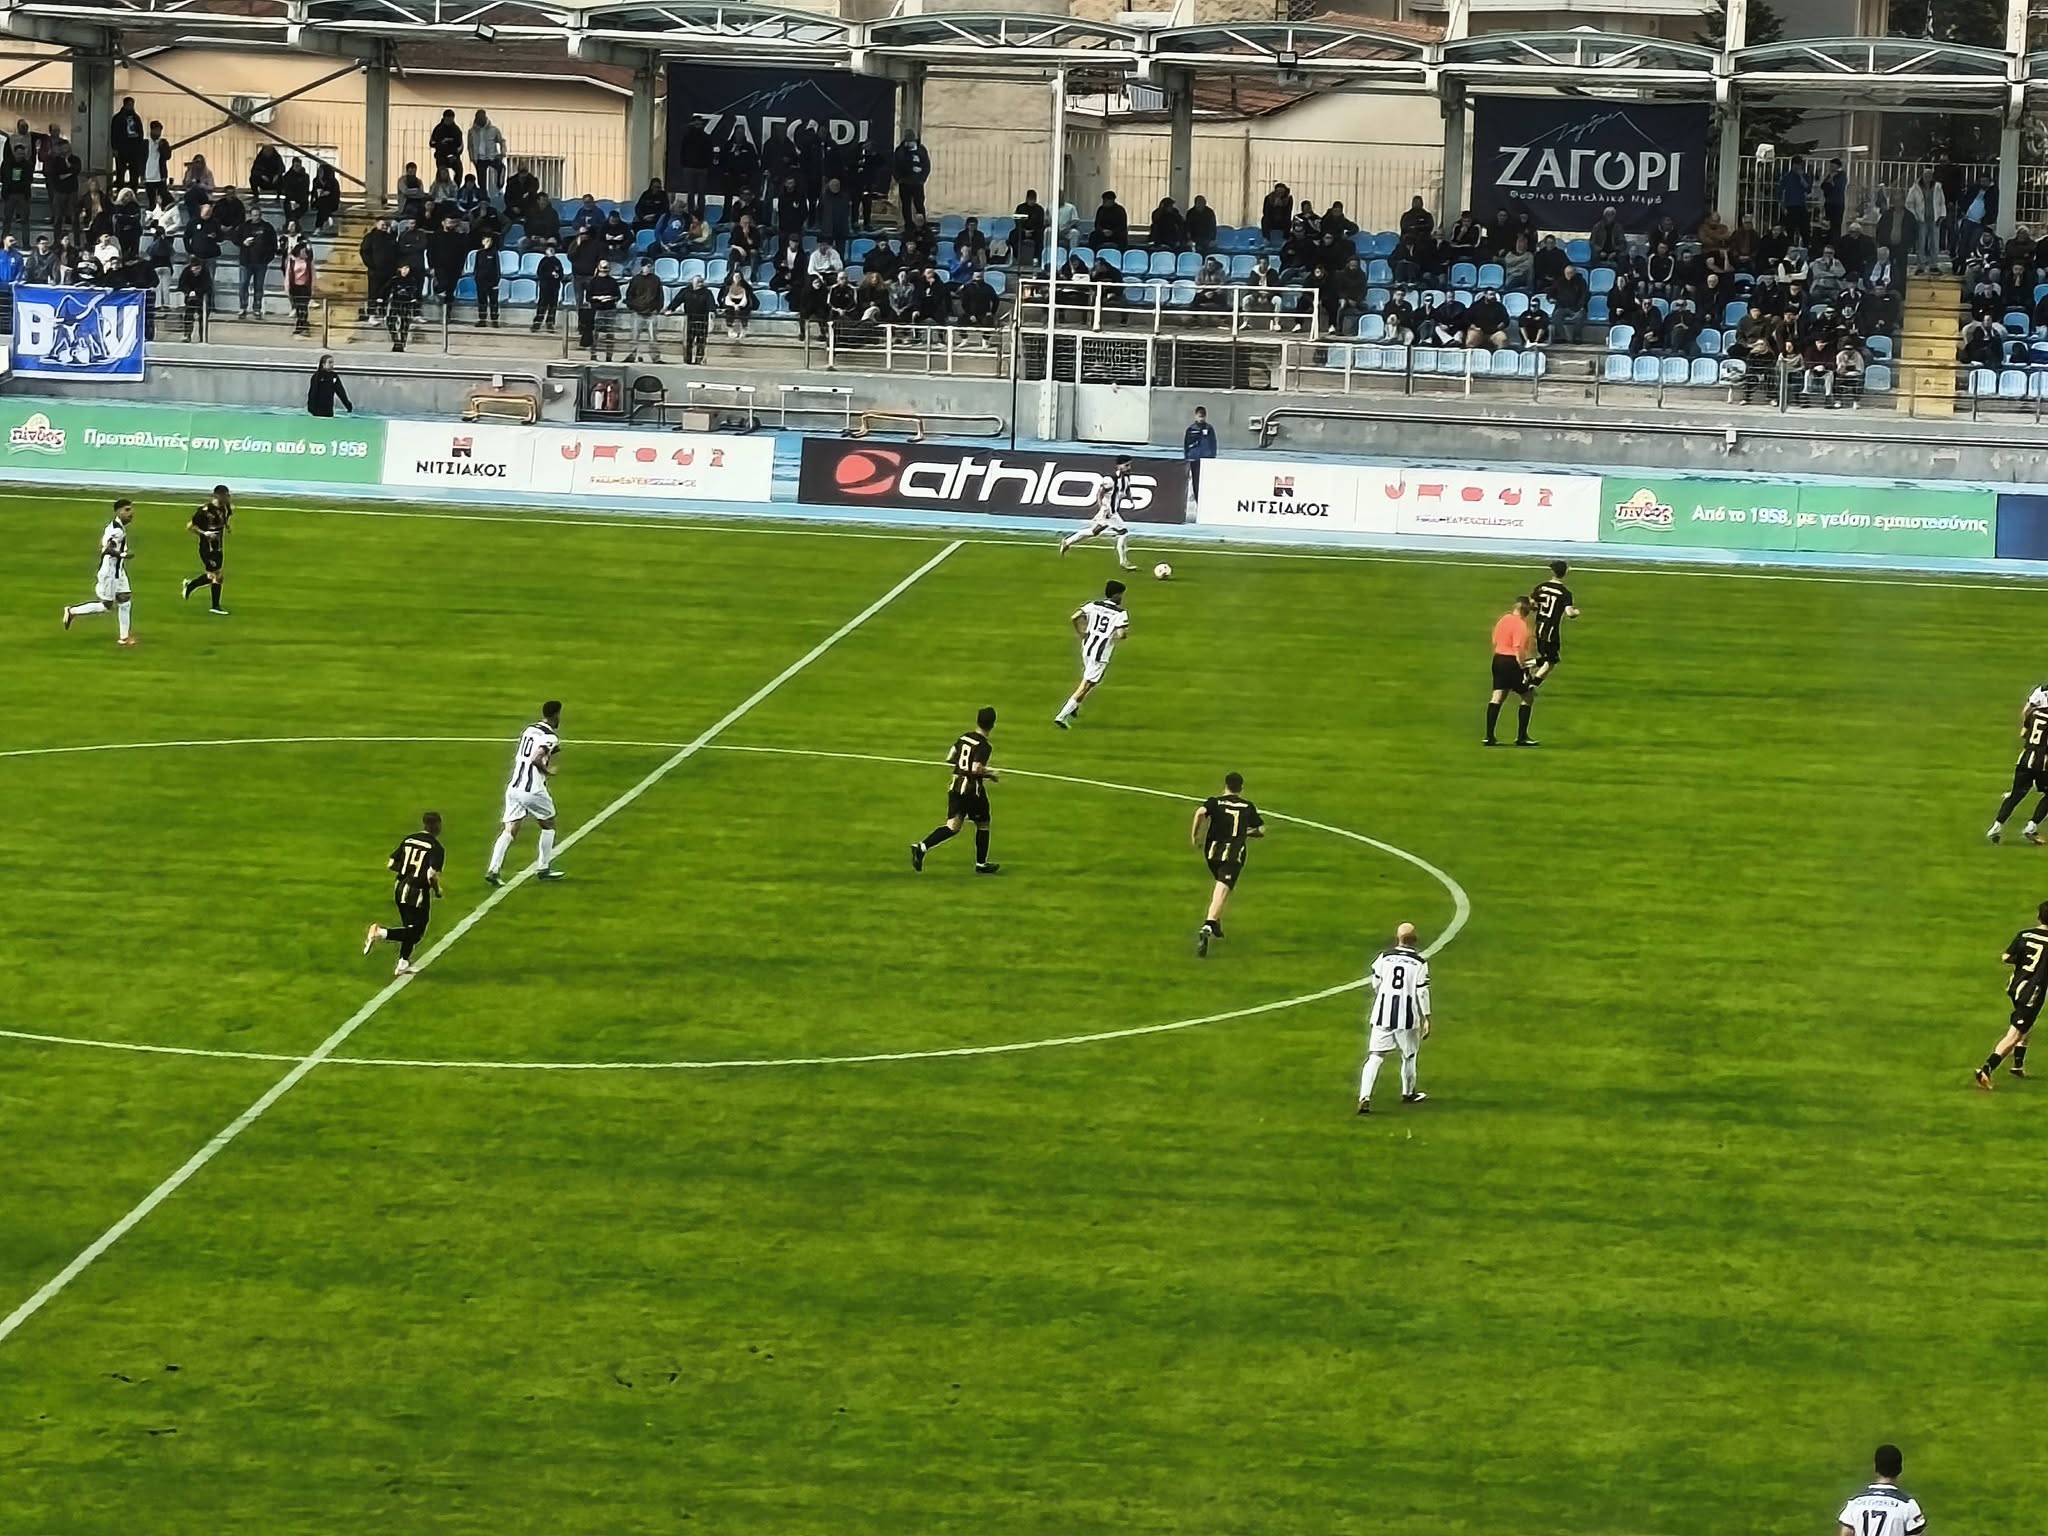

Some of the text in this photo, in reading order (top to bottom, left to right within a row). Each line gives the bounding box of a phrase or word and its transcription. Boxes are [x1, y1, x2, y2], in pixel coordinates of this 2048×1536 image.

[1496, 146, 1683, 191] ΖΑΓΟΡΙ
[17, 302, 55, 355] B
[84, 428, 368, 458] Πρωταθλητές στη γεύση από το 1958
[416, 461, 507, 478] ΝΙΤΣΙΑΚΟΣ
[898, 457, 1158, 510] athlos
[1237, 500, 1330, 517] ΝΙΤΣΙΑΚΟΣ
[1691, 505, 1989, 535] Από το 1958, με γεύση εμπιστοσύνης
[1094, 613, 1110, 633] 19
[2029, 718, 2047, 745] 6
[521, 736, 534, 757] 10
[959, 743, 971, 771] 8
[1225, 808, 1240, 837] 7
[401, 846, 427, 877] 14
[2022, 941, 2043, 972] 3
[1392, 966, 1405, 989] 8
[1863, 1510, 1888, 1536] 17
